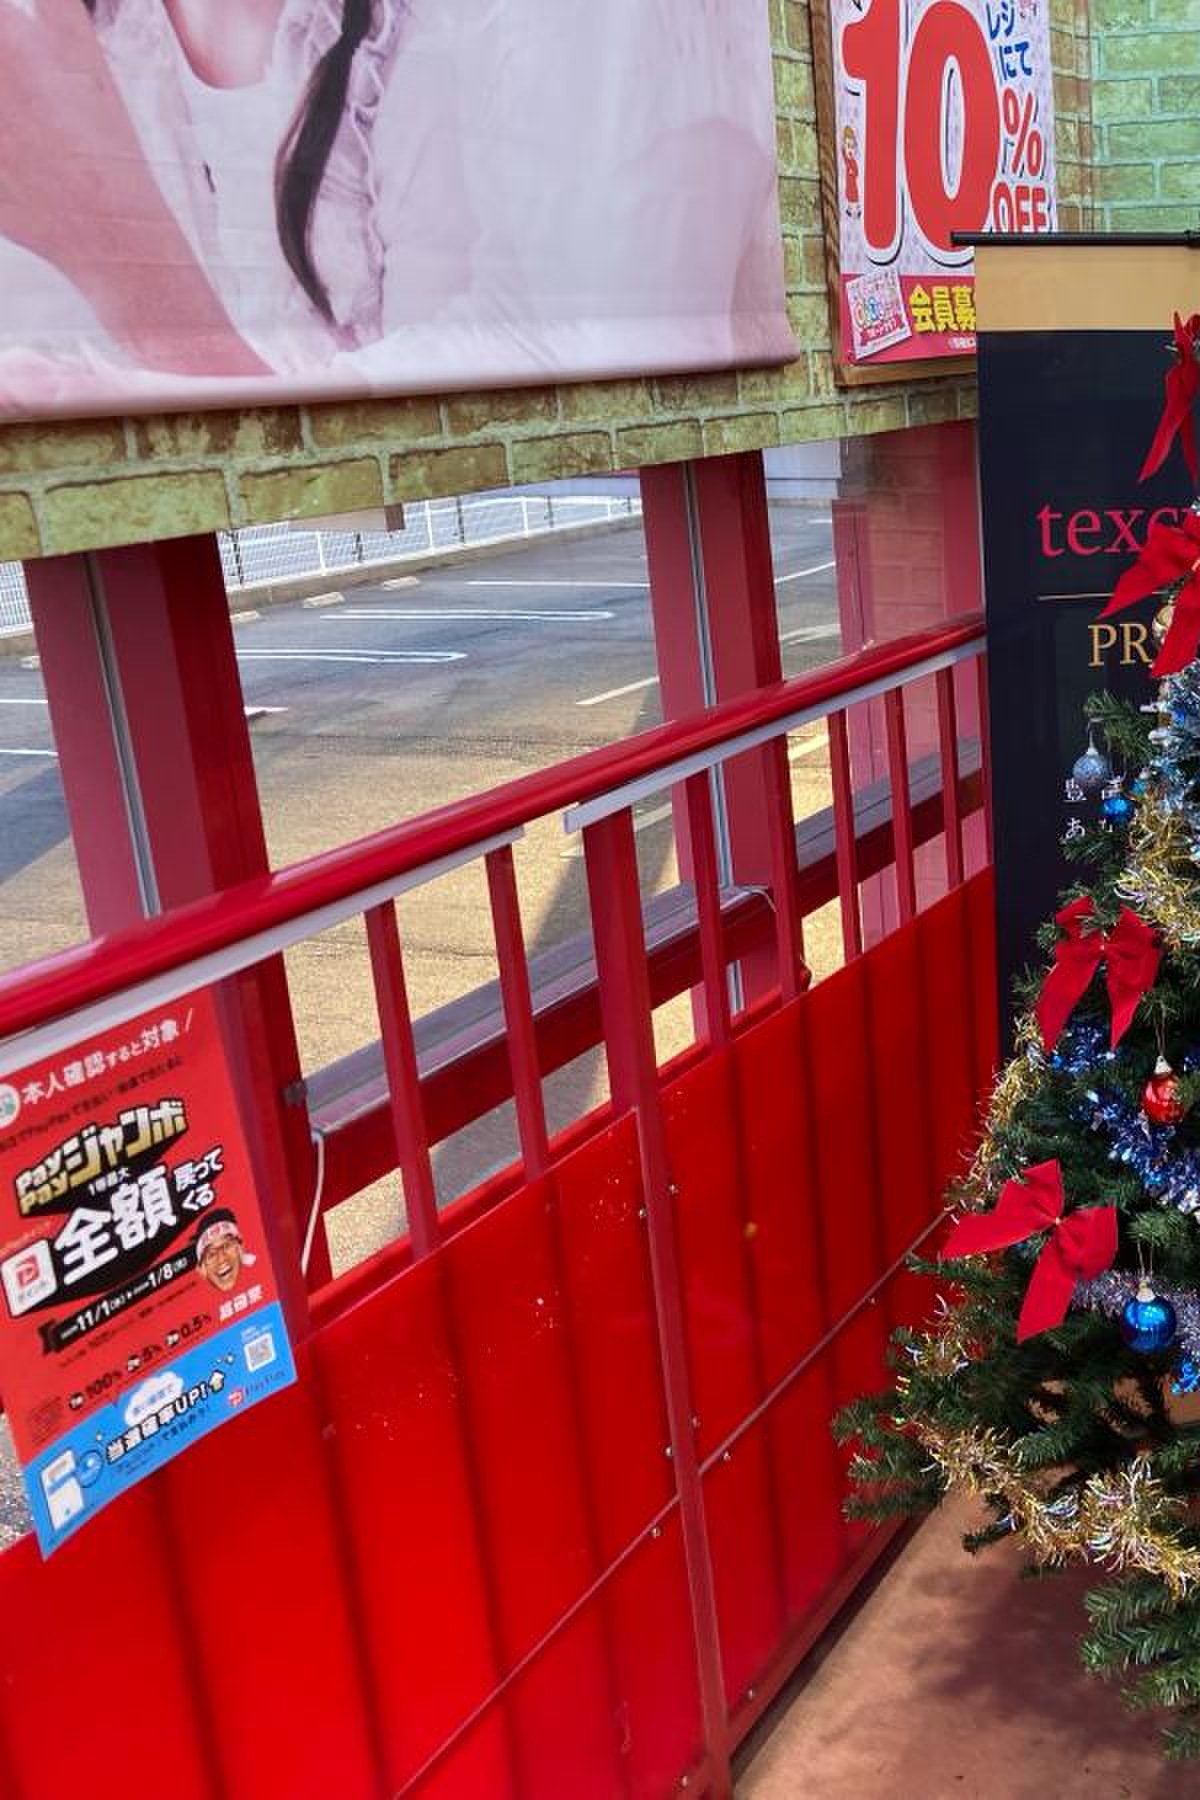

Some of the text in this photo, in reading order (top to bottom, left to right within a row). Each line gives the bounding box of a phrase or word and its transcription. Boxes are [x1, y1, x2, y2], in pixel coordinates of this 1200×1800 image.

[999, 41, 1032, 81] にて
[842, 0, 1000, 251] 10
[174, 1148, 224, 1192] 戻って
[182, 1184, 215, 1211] くる
[54, 1165, 177, 1285] 全額
